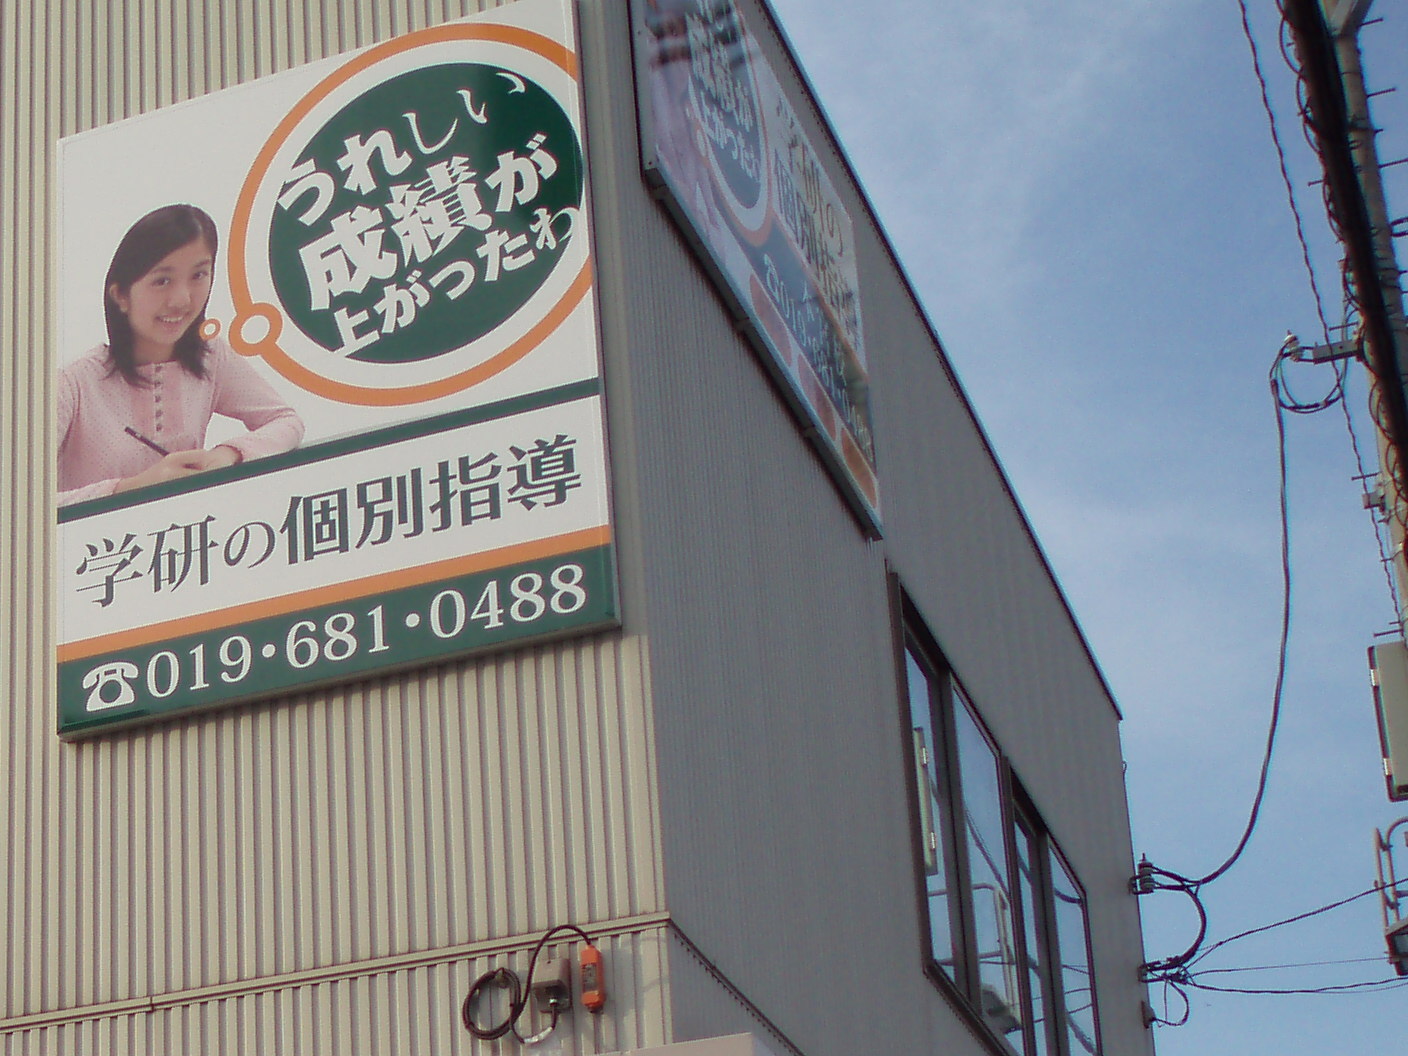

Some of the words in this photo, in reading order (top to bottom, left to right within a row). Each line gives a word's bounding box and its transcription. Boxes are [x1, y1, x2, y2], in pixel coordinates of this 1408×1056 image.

[279, 72, 526, 229] うれしい
[301, 134, 556, 312] 成績が
[75, 435, 581, 607] 学研の個別指導
